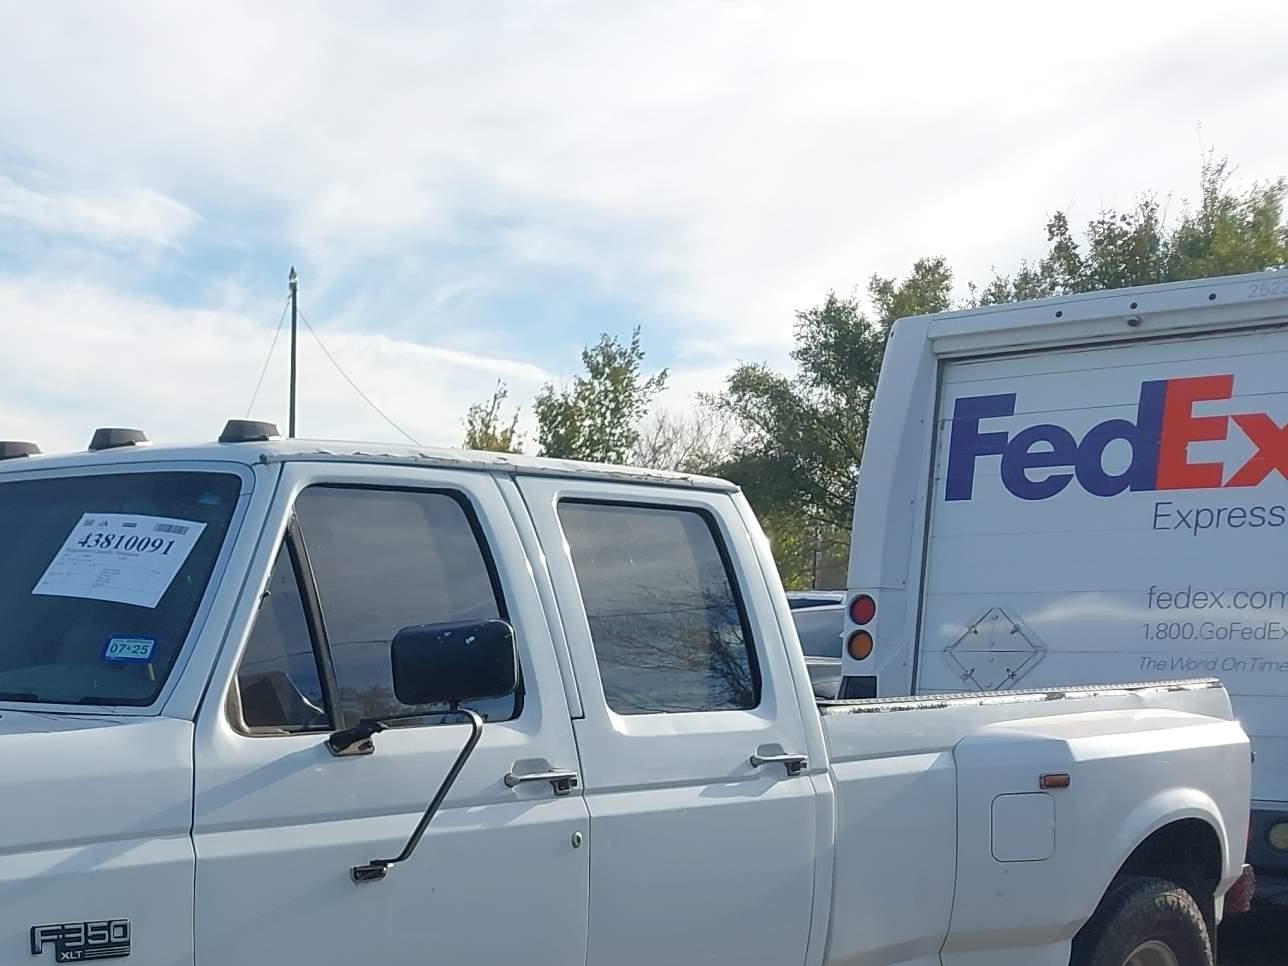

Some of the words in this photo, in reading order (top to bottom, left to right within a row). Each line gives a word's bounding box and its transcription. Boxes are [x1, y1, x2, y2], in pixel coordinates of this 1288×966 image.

[945, 374, 1288, 501] FedEx
[1153, 501, 1286, 536] Express
[78, 532, 175, 555] 43810091
[1146, 584, 1288, 610] fedex.com
[1139, 656, 1168, 671] The
[1222, 656, 1248, 672] On
[60, 950, 83, 961] XLT
